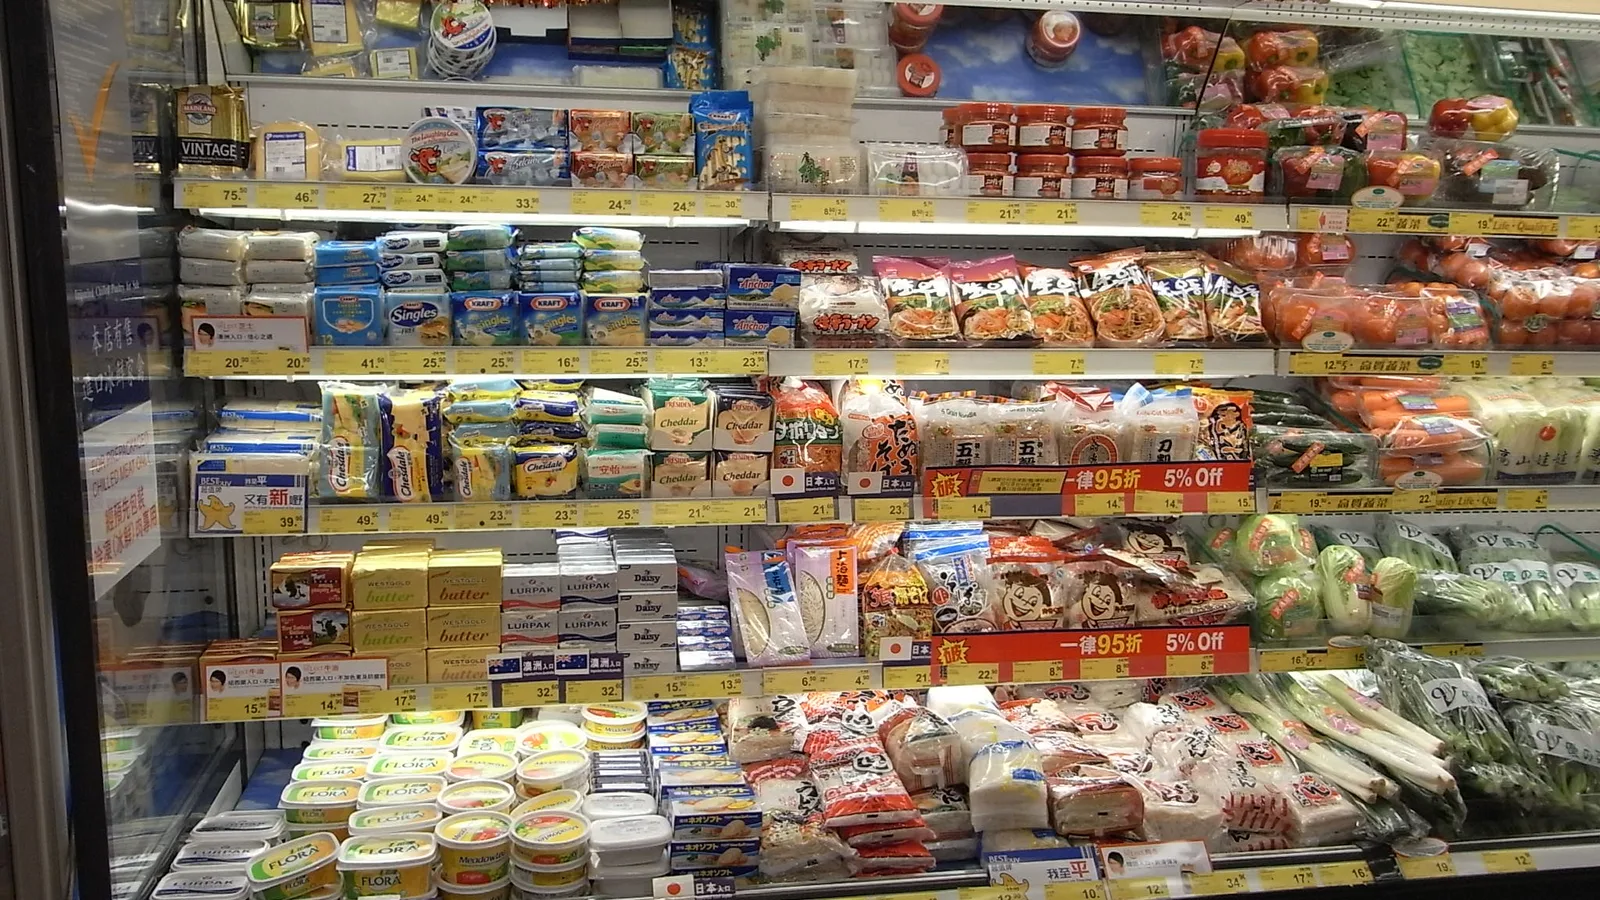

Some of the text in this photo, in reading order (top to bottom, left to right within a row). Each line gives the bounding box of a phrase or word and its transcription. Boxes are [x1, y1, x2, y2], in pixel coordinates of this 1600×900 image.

[182, 142, 237, 158] VINTAGE
[739, 278, 774, 290] Anchor
[471, 300, 494, 308] KRAFT
[538, 300, 562, 308] KRAFT
[391, 308, 438, 322] Singles
[476, 315, 511, 330] singles
[544, 314, 577, 331] singles
[606, 316, 640, 332] singles
[734, 320, 769, 330] Anchor
[660, 418, 698, 428] Cheddar
[726, 421, 764, 430] Cheddar
[888, 420, 918, 475] たぬき
[336, 441, 347, 488] Chesdale
[527, 460, 563, 472] Chesdale
[400, 451, 412, 497] Chesdale
[461, 460, 472, 496] Chesdale
[659, 474, 698, 484] Cheddar
[722, 471, 761, 482] Cheddar
[1164, 467, 1224, 488] 5% Off
[634, 574, 661, 584] Daisy
[510, 586, 554, 595] LURPAK
[567, 582, 610, 591] LURPAK
[366, 588, 414, 602] butter
[440, 588, 490, 601] butter
[636, 604, 662, 614] Daisy
[508, 622, 551, 630] LURPAK
[565, 620, 608, 629] LURPAK
[362, 632, 413, 646] butter
[440, 630, 489, 642] butter
[634, 632, 660, 642] Daisy
[1166, 632, 1224, 652] 5% Off
[634, 662, 660, 671] Daisy
[397, 734, 448, 742] FLORA
[302, 790, 349, 798] FLORA
[376, 787, 432, 797] FLORA
[688, 816, 722, 824] ネオソフト
[358, 844, 420, 855] FLORA
[685, 844, 719, 852] ネオソフト
[269, 846, 320, 871] FLORA
[361, 876, 402, 886] FLORA
